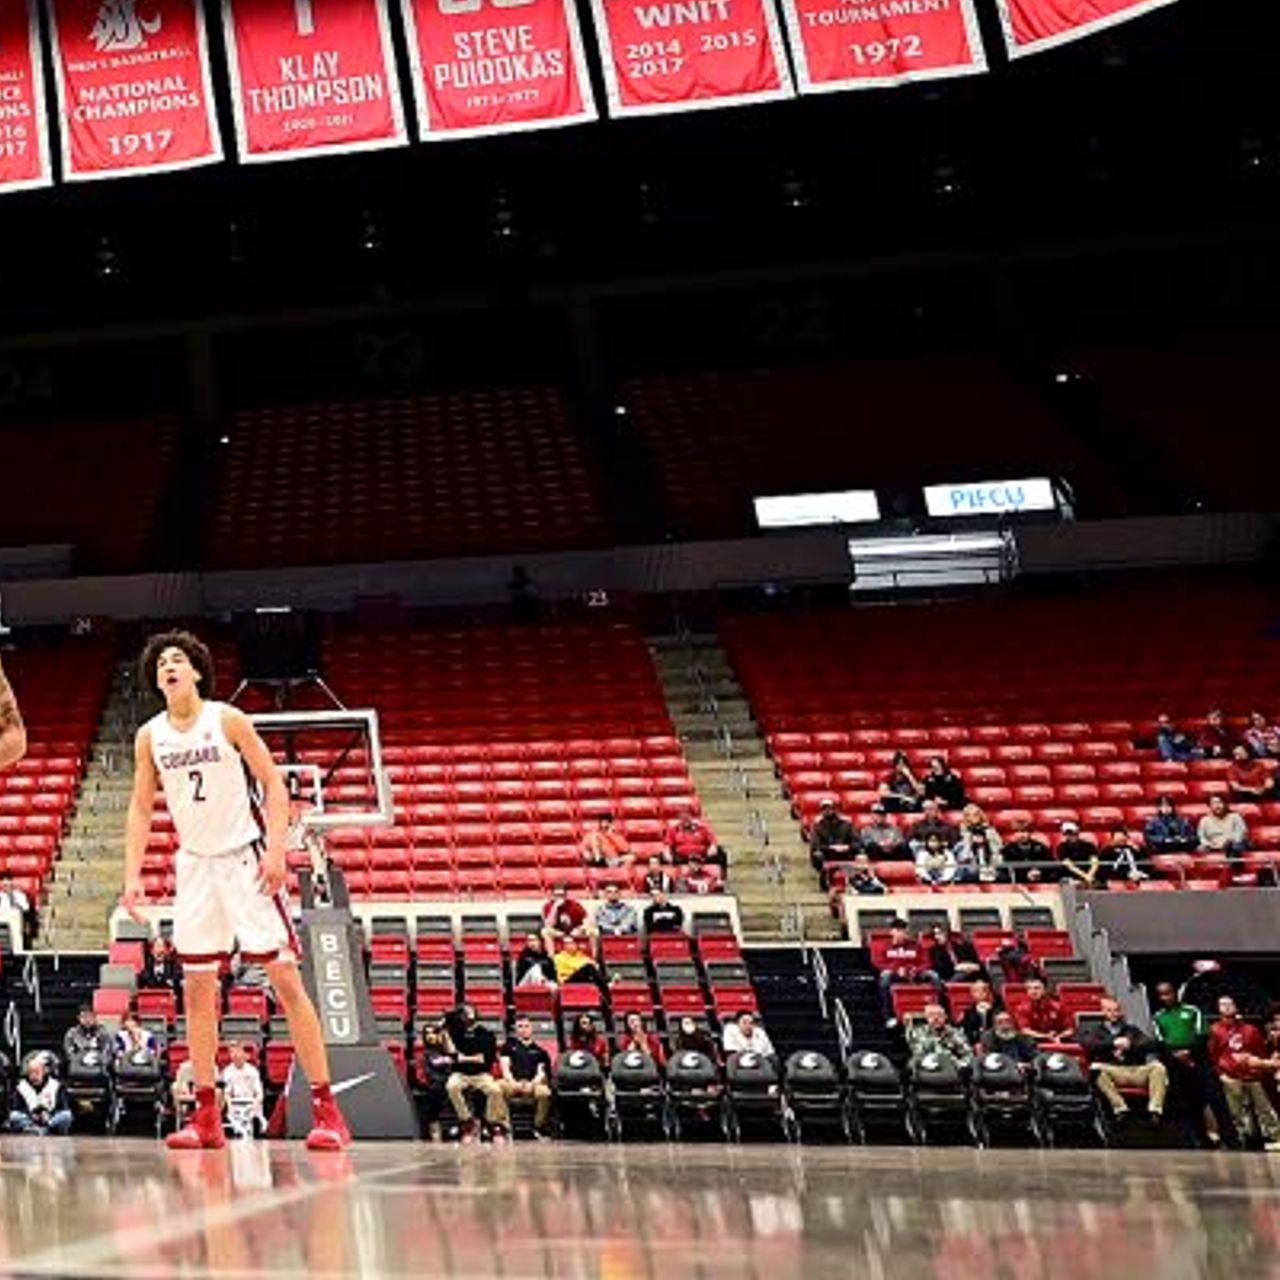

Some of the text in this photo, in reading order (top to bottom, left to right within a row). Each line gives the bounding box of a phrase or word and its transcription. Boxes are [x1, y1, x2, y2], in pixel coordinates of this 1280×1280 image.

[454, 24, 535, 60] STEVE
[626, 29, 757, 60] 2014 2015
[849, 35, 923, 65] 1972
[279, 51, 340, 80] KLAY
[433, 48, 565, 91] PUIDOKAS
[629, 56, 684, 80] 2017
[80, 75, 188, 103] NATIONAL
[247, 73, 384, 114] THOMPSON
[74, 93, 200, 123] CHAMPIONS
[108, 130, 173, 155] 1917
[160, 744, 221, 770] COUGARS
[188, 769, 207, 802] 2
[320, 933, 351, 1038] BECU
